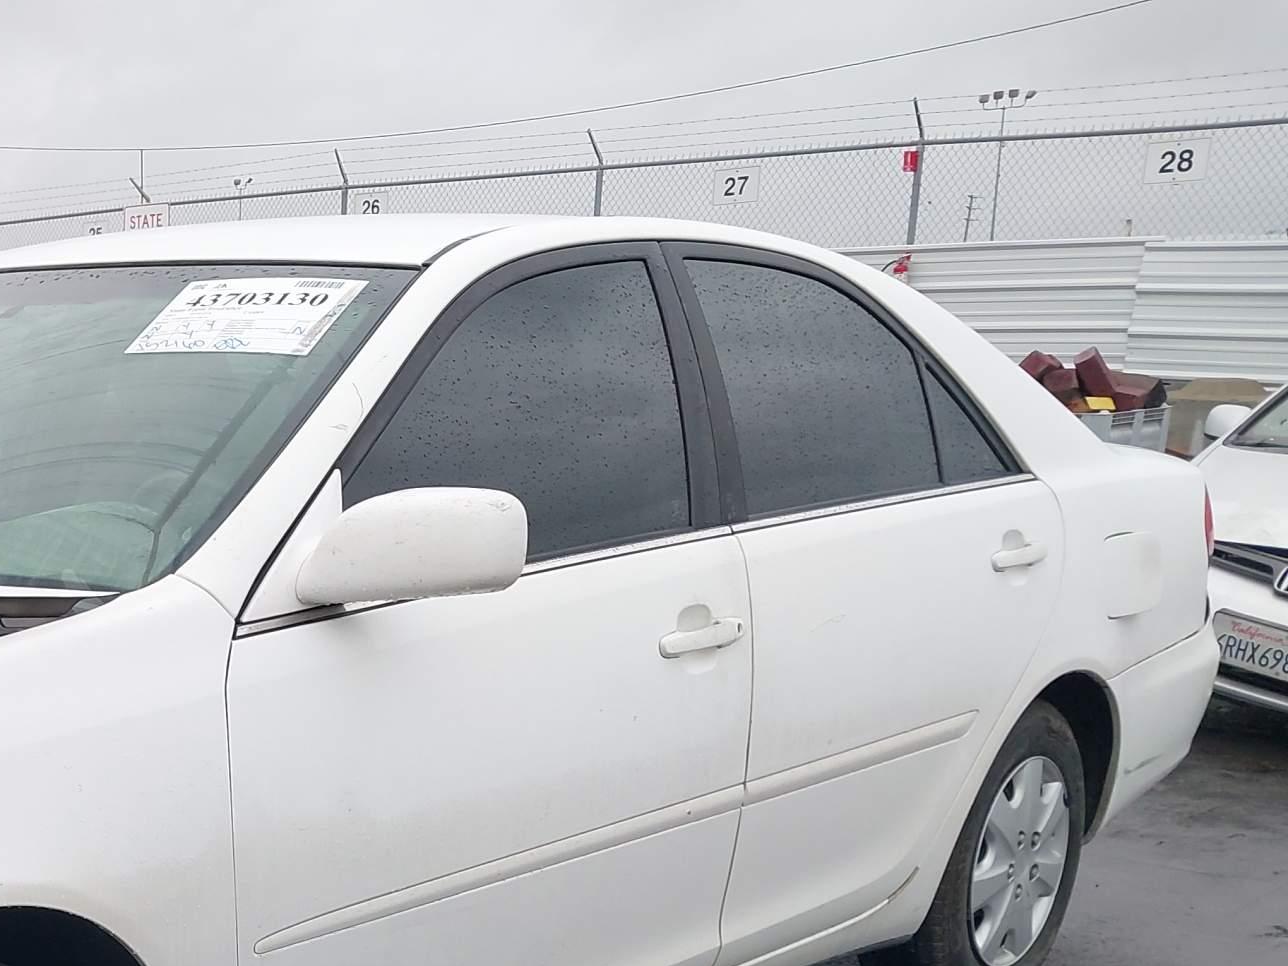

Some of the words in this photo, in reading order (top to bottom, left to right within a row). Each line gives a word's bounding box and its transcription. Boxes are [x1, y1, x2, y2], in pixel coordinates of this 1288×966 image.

[1158, 149, 1194, 174] 28
[723, 175, 750, 197] 27
[362, 199, 380, 215] 26
[129, 213, 163, 230] STATE
[185, 291, 329, 307] 43703130
